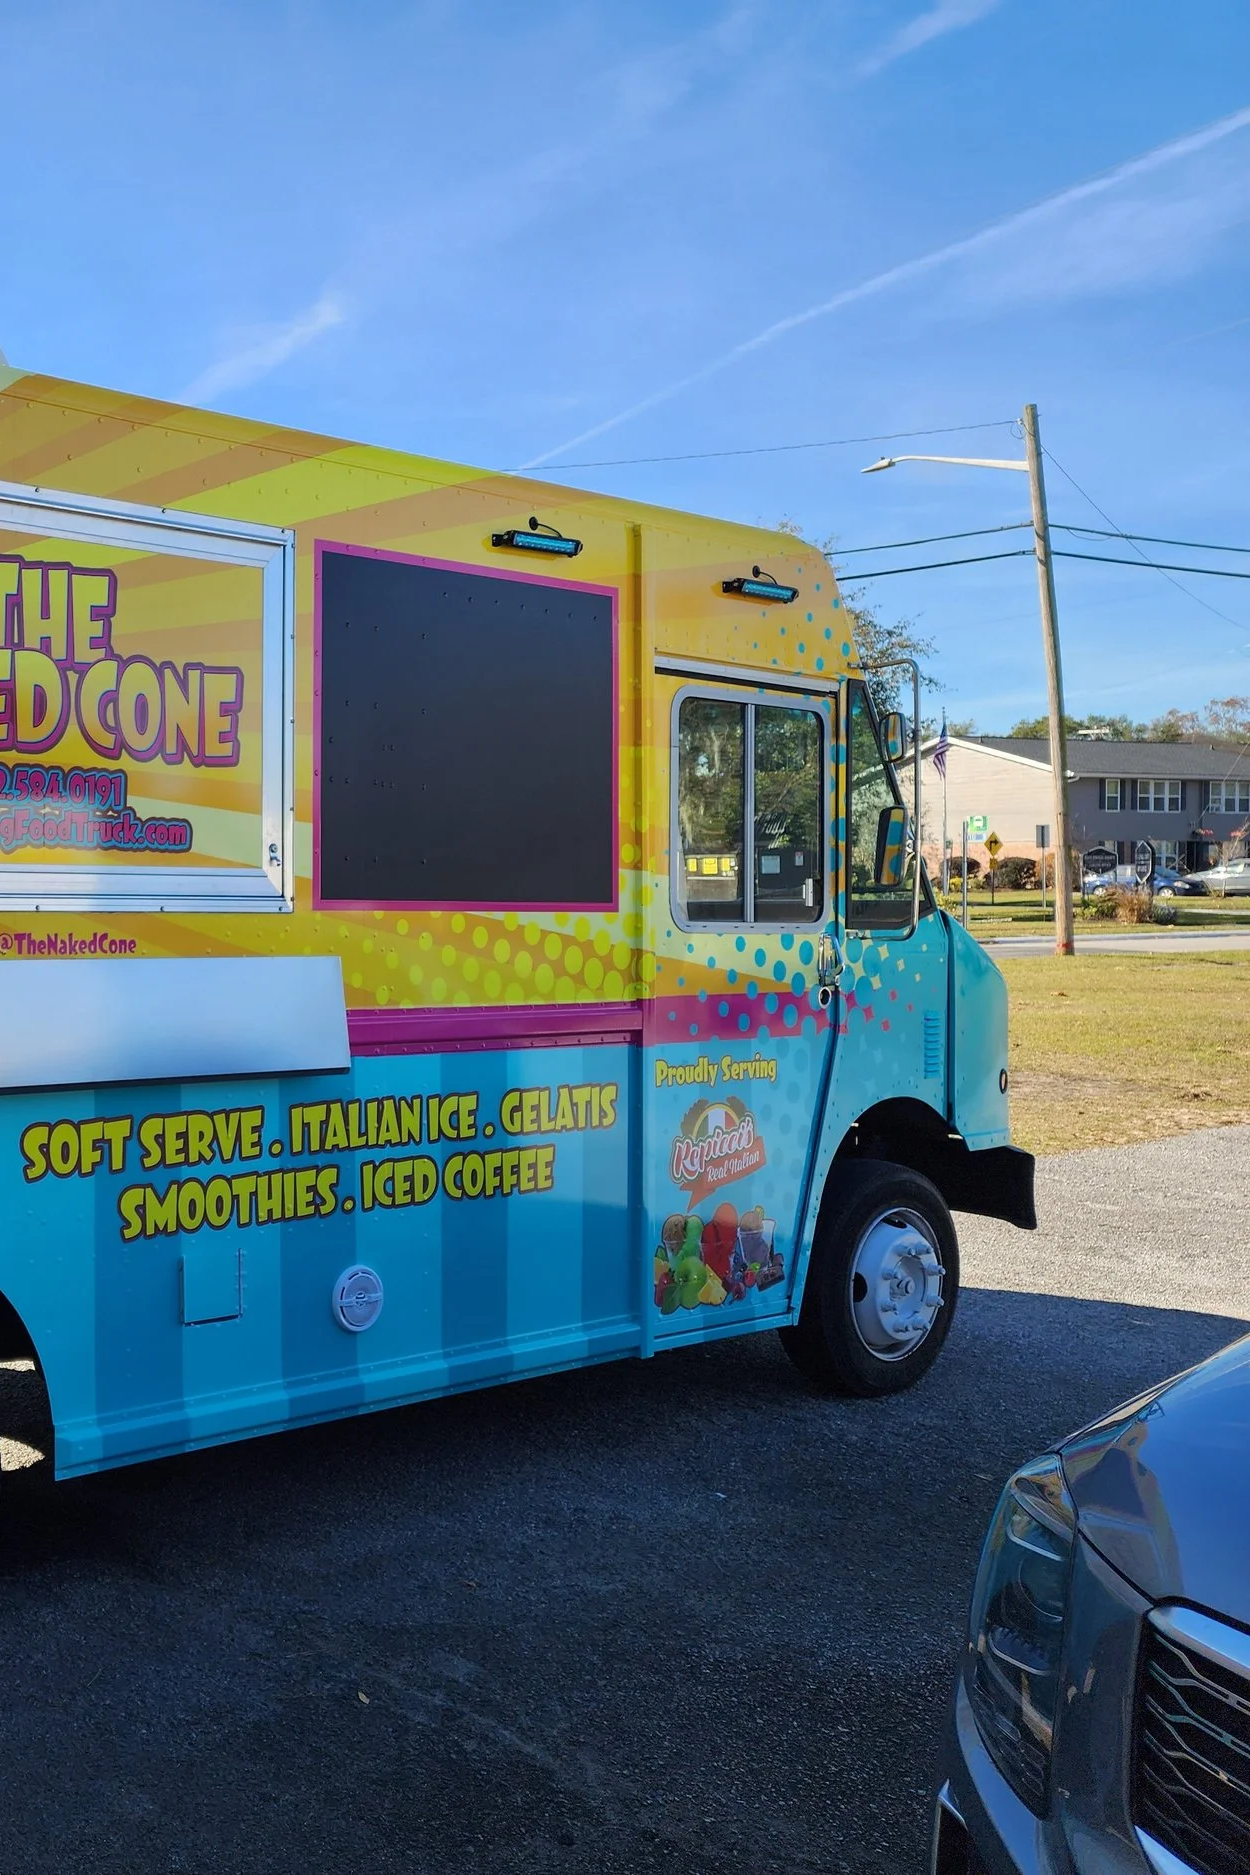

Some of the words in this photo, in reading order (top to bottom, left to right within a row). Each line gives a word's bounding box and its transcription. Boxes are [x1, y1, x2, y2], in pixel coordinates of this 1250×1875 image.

[76, 655, 243, 767] CONE
[655, 1055, 718, 1087] Proudly
[722, 1053, 777, 1082] Serving
[21, 1117, 131, 1182] SOFT
[138, 1106, 264, 1168] SERVE
[289, 1095, 423, 1154] ITALIAN
[427, 1090, 479, 1141] ICE
[499, 1082, 619, 1137] GELATIS
[707, 1161, 729, 1183] Real
[729, 1150, 760, 1175] Italian
[117, 1165, 340, 1243] SMOOTHIES
[359, 1154, 438, 1210] ICED
[443, 1146, 556, 1202] COFFEE
